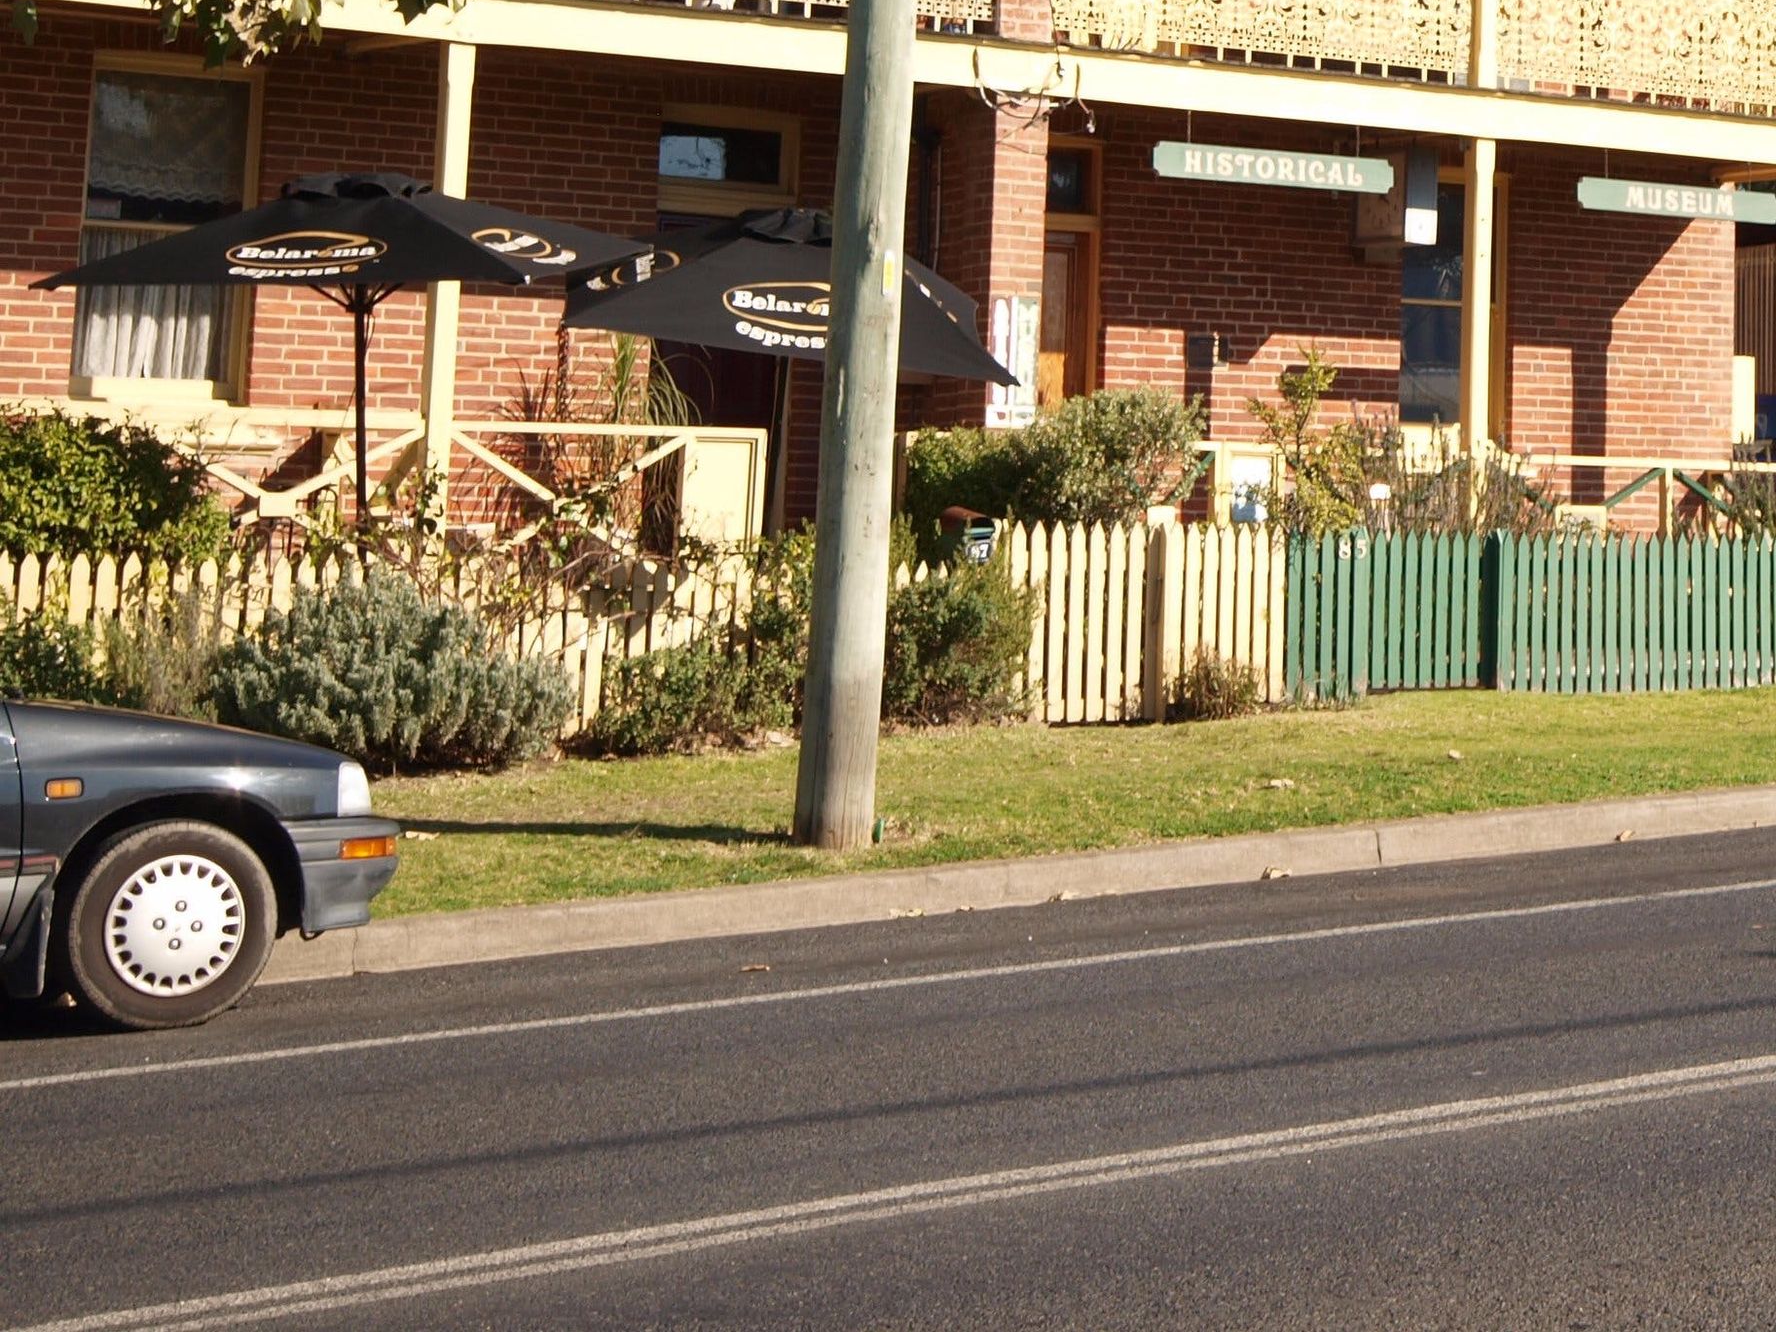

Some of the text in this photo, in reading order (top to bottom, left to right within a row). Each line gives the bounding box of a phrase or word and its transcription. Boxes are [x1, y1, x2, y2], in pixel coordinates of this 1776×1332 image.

[1184, 149, 1363, 187] HISTORICAL
[1625, 185, 1734, 217] MUSEUM
[1338, 536, 1367, 559] 85
